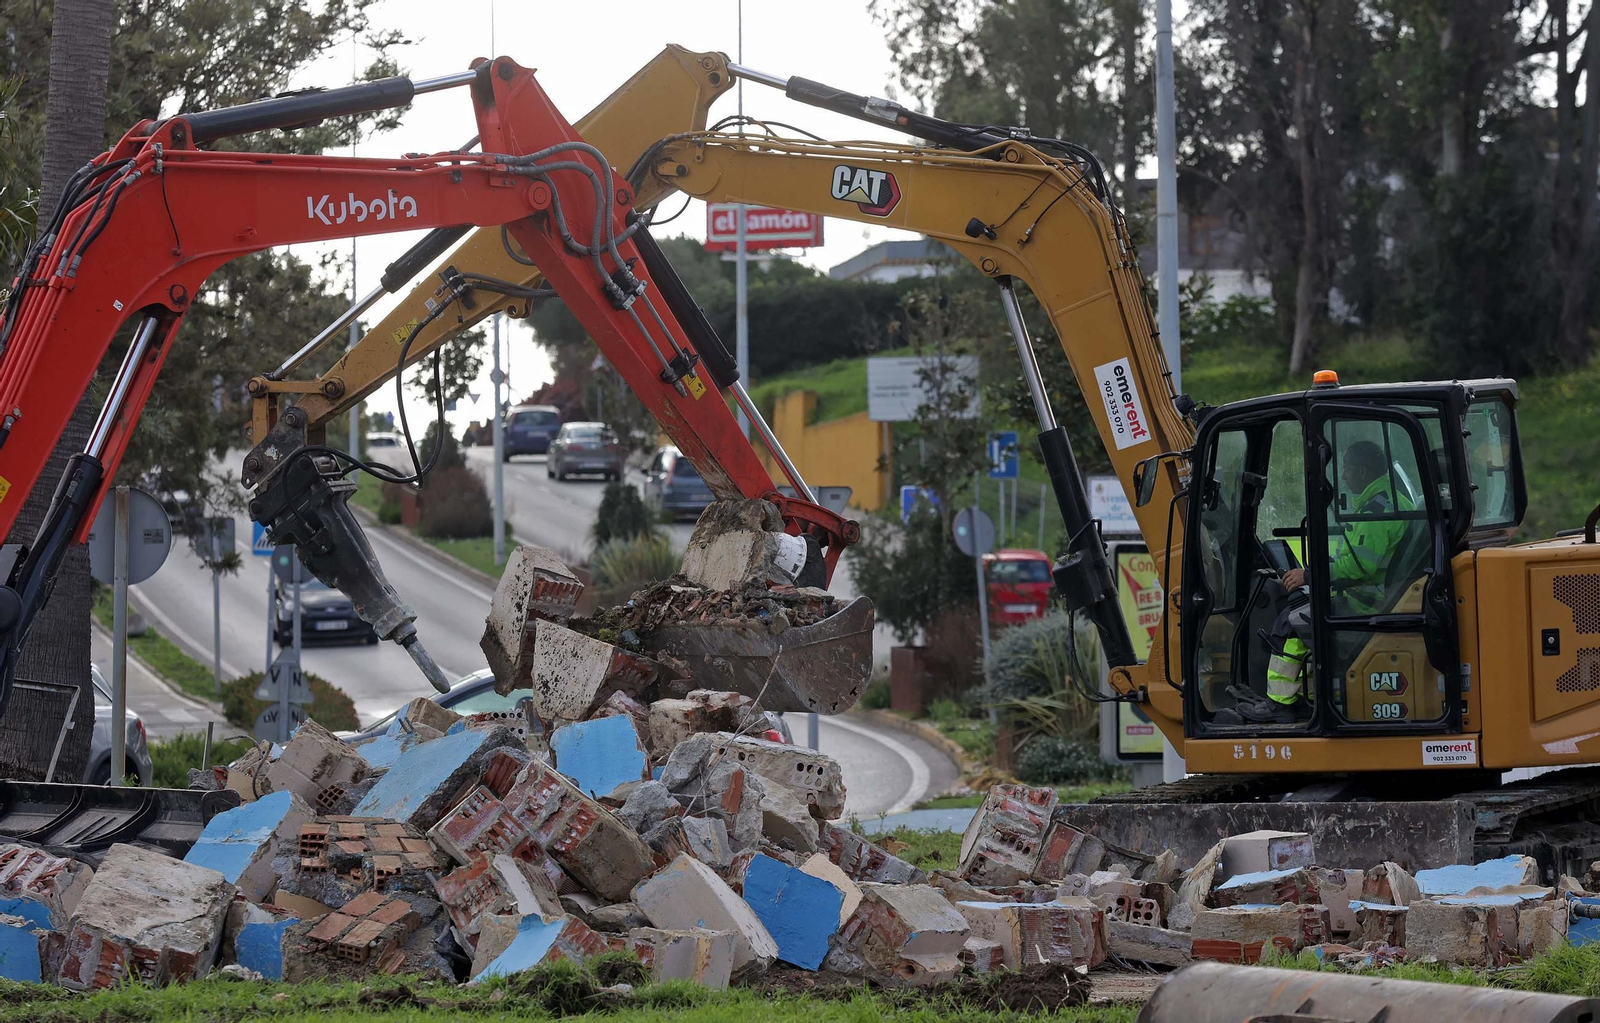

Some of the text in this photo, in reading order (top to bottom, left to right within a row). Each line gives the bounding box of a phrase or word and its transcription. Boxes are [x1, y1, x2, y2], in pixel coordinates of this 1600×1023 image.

[831, 165, 887, 205] CAT
[306, 188, 418, 225] Kubota
[745, 210, 809, 231] amón
[1104, 380, 1114, 398] 902
[1109, 399, 1119, 415] 333
[1114, 416, 1125, 434] 070
[1113, 365, 1148, 440] emerent
[1370, 672, 1399, 691] CAT
[1372, 703, 1400, 719] 309
[1425, 741, 1473, 753] emerent
